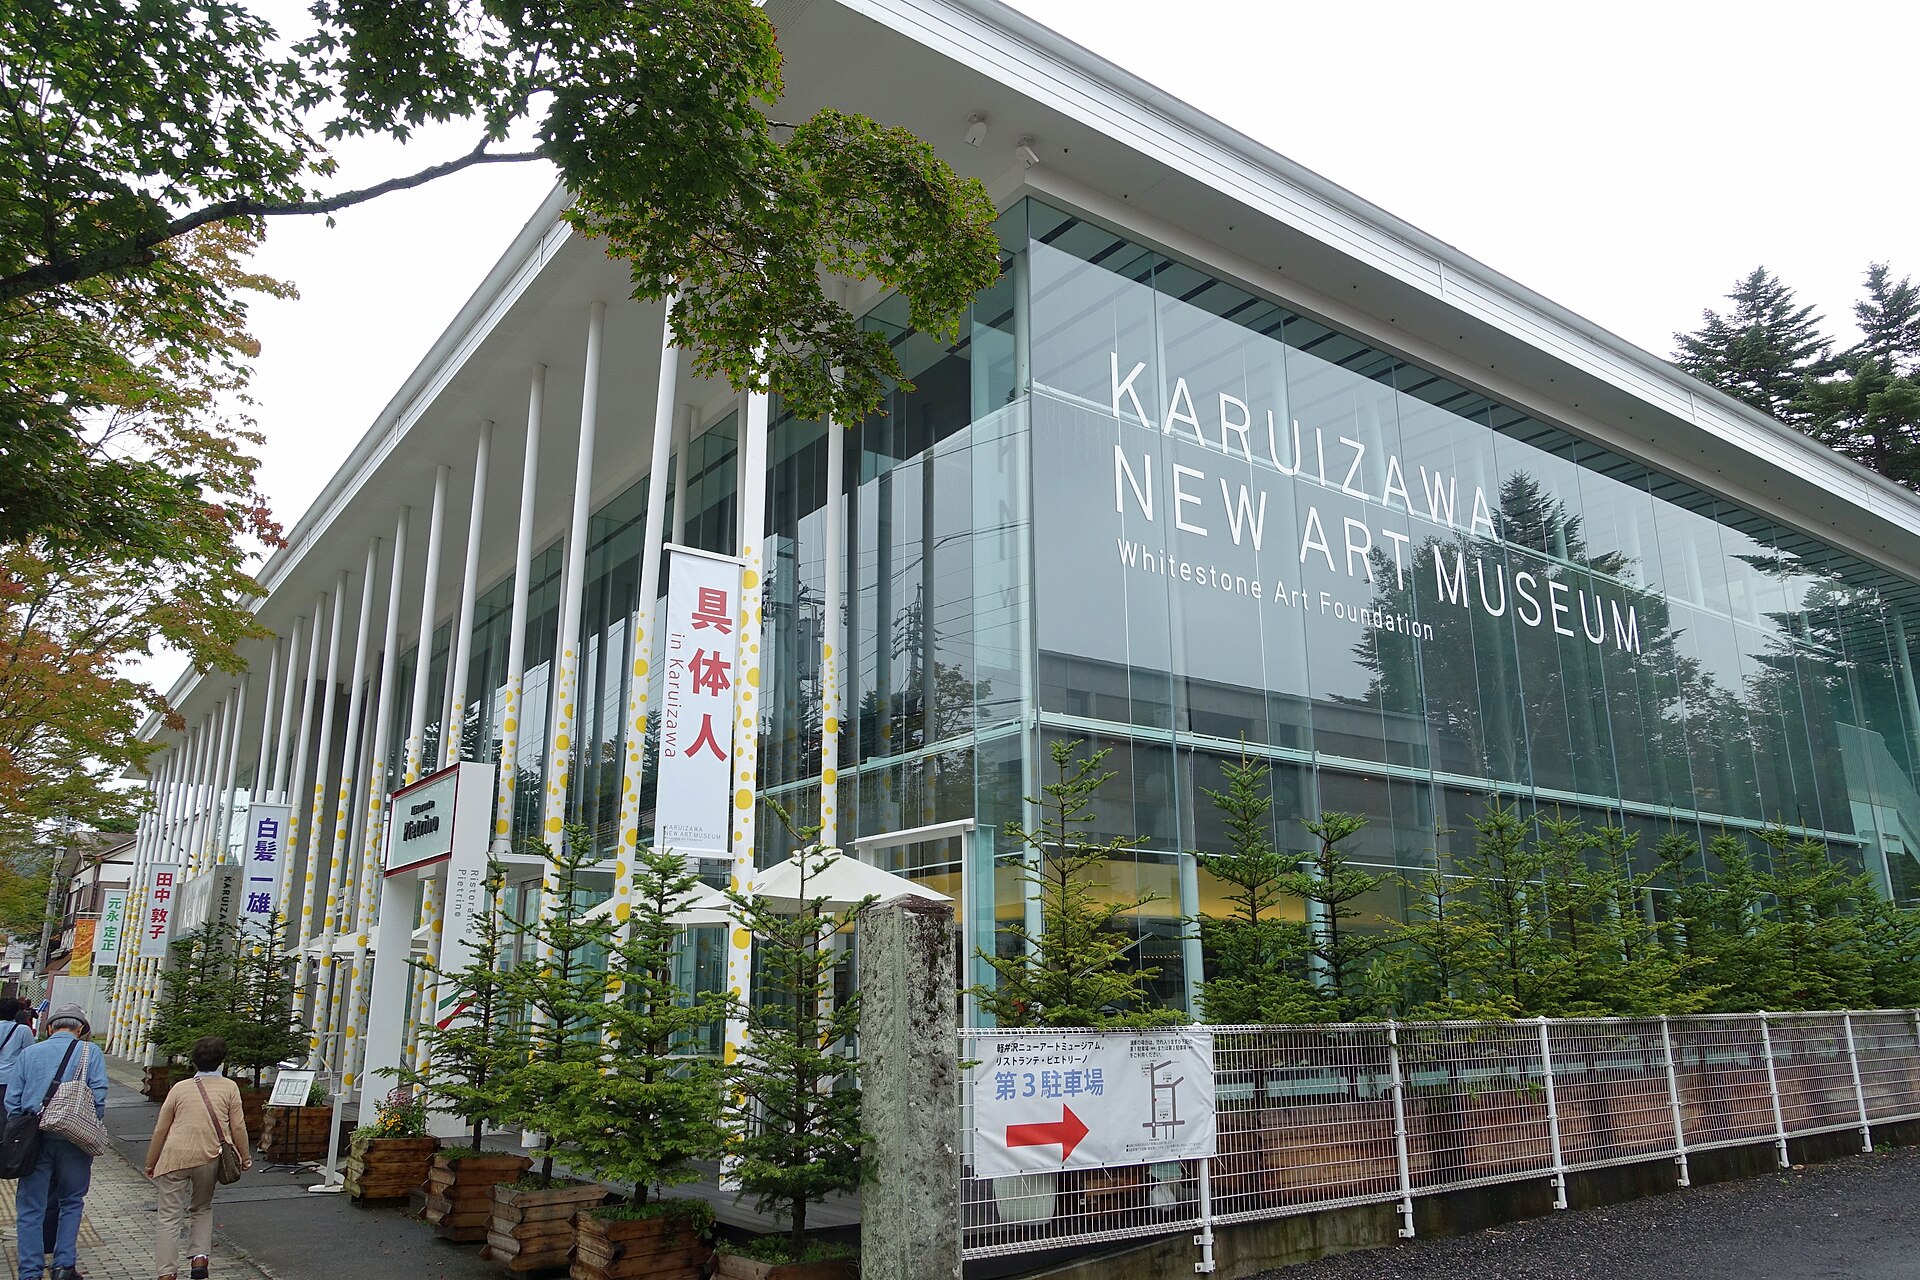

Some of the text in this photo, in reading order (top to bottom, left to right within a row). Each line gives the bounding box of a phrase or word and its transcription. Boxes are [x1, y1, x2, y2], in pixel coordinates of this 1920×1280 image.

[1111, 352, 1500, 544] KARUIZAWA
[1114, 444, 1641, 655] NEW ART MUSEUM
[1117, 538, 1435, 642] Whitestone Art Foundation
[664, 633, 686, 759] in Karuizawa
[684, 586, 733, 763] 具体人
[246, 818, 279, 914] 白髪一雄
[693, 832, 722, 841] MUSEUM
[465, 870, 480, 934] Ristorante
[994, 1068, 1104, 1101] 第3駐車場
